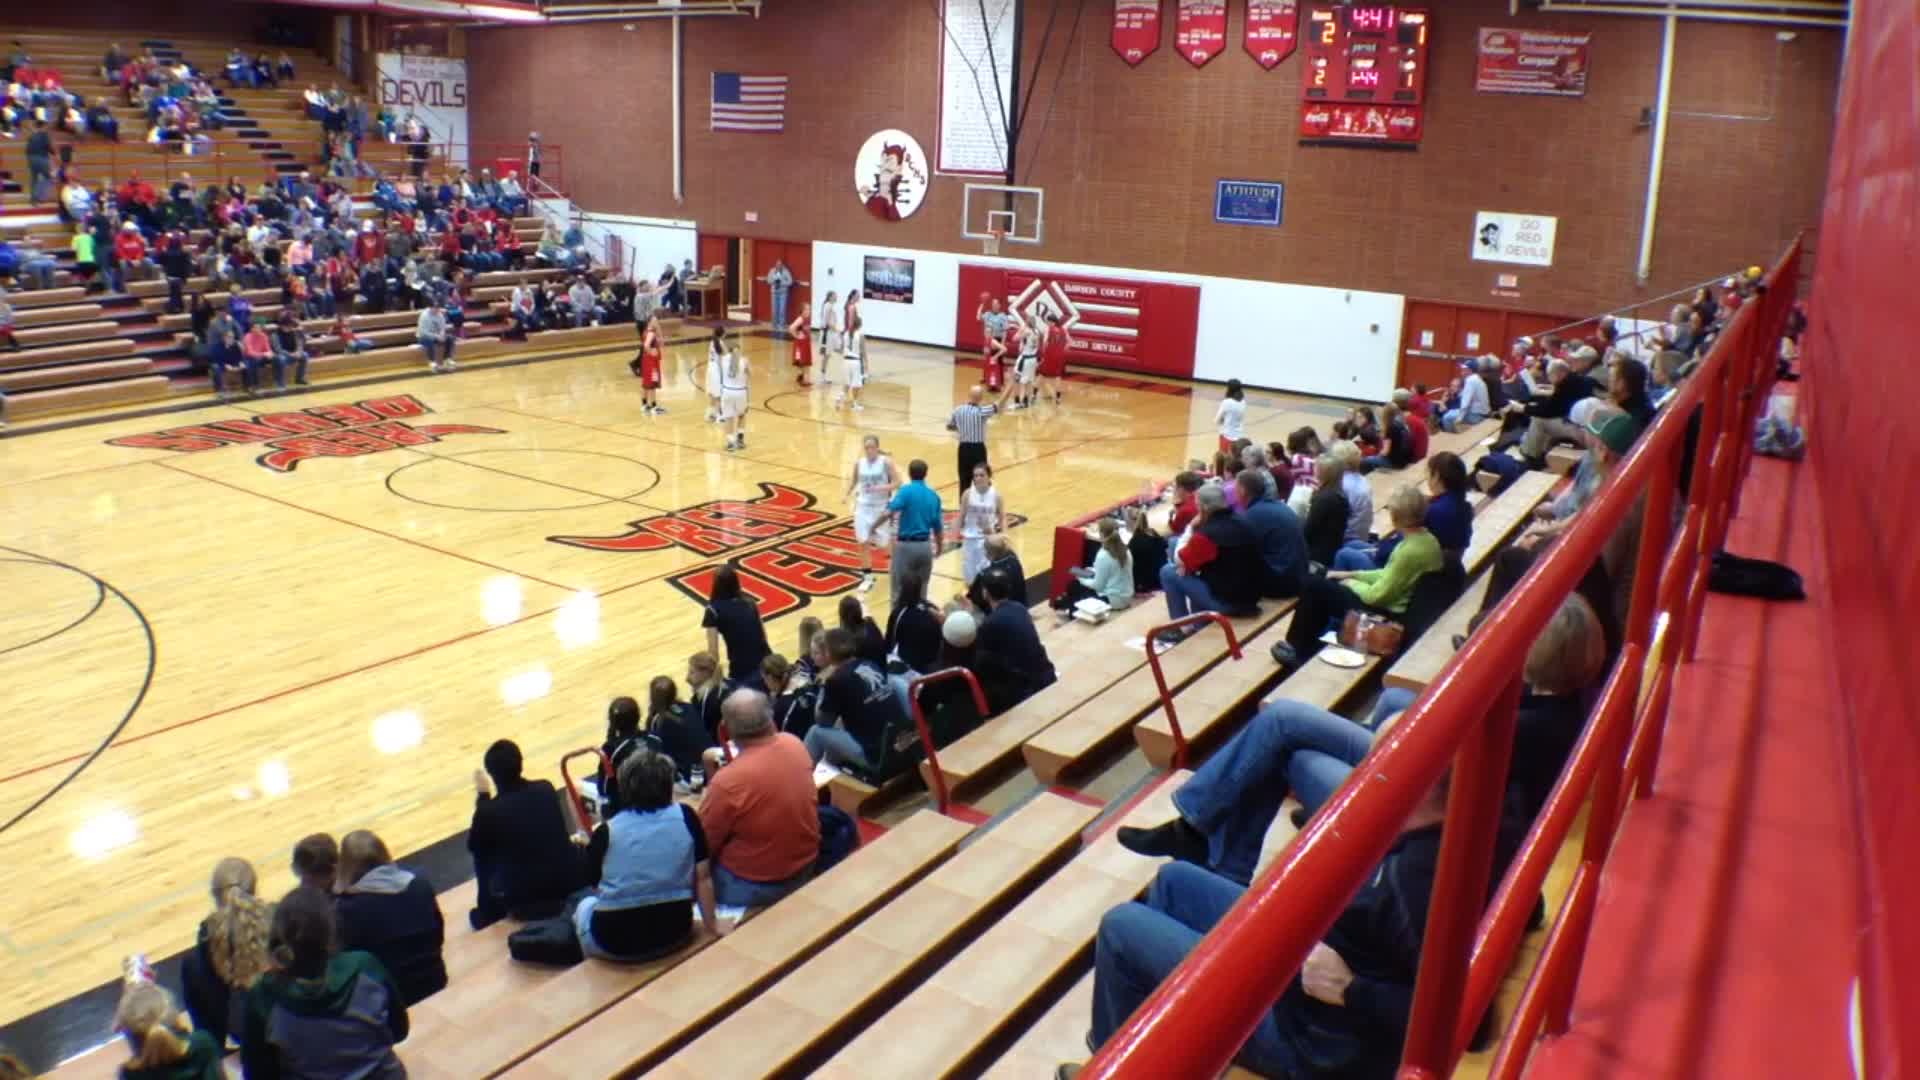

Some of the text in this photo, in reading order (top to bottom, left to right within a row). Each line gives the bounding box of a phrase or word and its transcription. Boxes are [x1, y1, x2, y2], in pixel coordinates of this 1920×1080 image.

[1353, 8, 1394, 28] 4:41
[1322, 21, 1336, 43] 2
[1418, 25, 1425, 44] 1
[1314, 69, 1326, 85] 2
[1407, 73, 1413, 87] 1
[383, 79, 466, 107] DEVILS
[1521, 219, 1540, 230] GO
[1515, 231, 1543, 243] RED
[1504, 245, 1549, 258] DEVILS
[1100, 288, 1136, 298] COUNTY
[608, 484, 838, 557] RED
